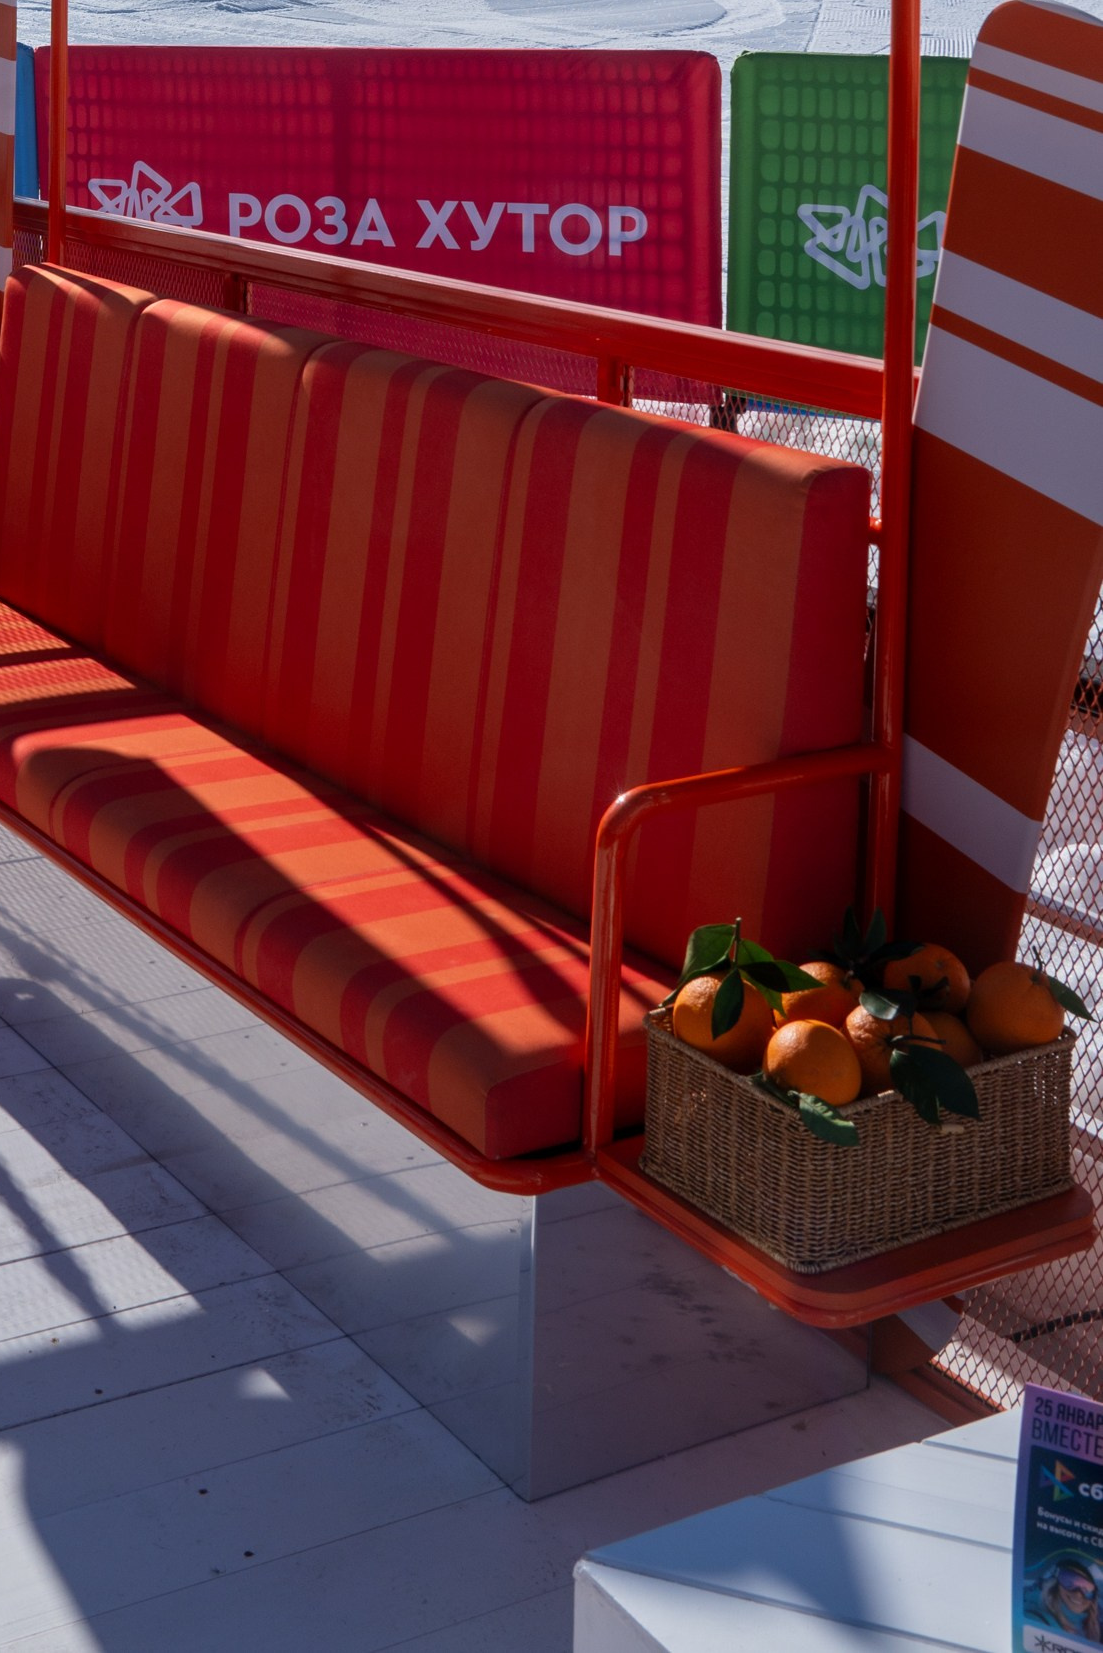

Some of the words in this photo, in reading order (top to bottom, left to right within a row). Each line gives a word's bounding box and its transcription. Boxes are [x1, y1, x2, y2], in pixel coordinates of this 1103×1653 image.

[228, 192, 396, 248] РОЗА
[416, 198, 648, 257] ХУТОР
[1034, 1396, 1053, 1417] 25
[1031, 1417, 1103, 1459] ВМЕСТЕ
